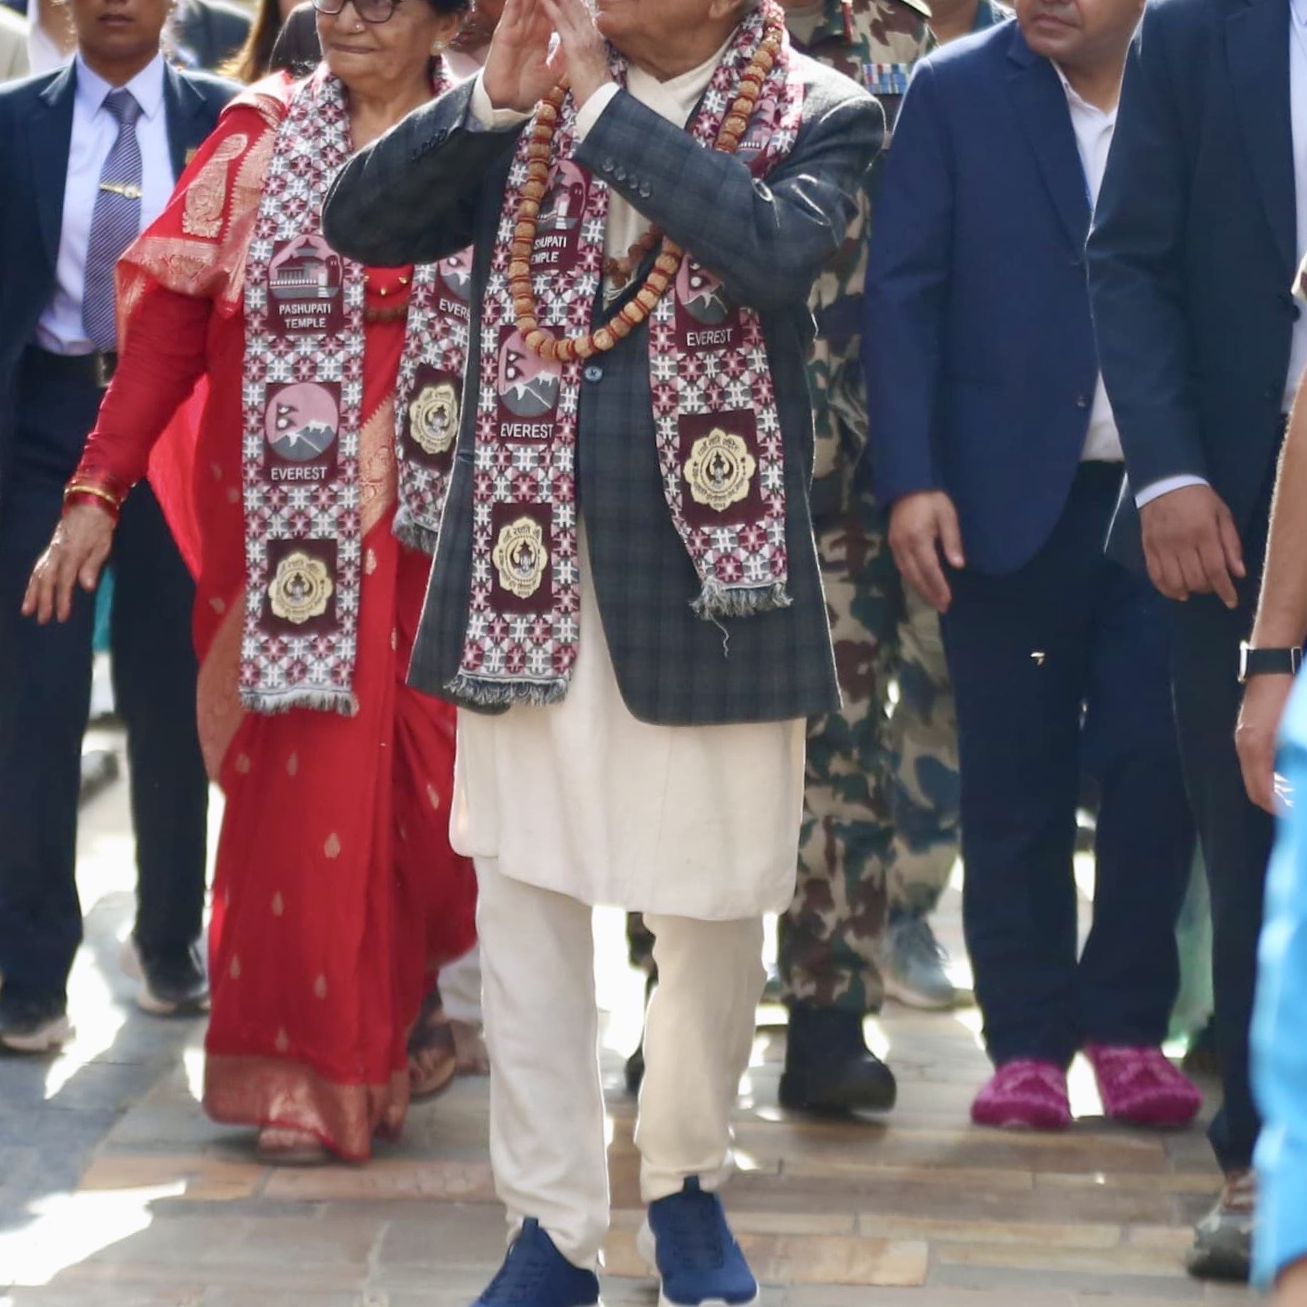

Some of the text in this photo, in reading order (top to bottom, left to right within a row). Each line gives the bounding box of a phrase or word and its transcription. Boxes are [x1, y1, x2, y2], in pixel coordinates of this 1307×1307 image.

[534, 235, 567, 250] SHUPATI
[531, 251, 559, 264] EMPLE
[278, 303, 331, 315] PASHUPATI
[439, 297, 470, 319] EVER
[284, 317, 326, 329] TEMPLE
[686, 328, 733, 346] EVEREST
[500, 422, 554, 439] EVEREST
[270, 466, 328, 480] EVEREST
